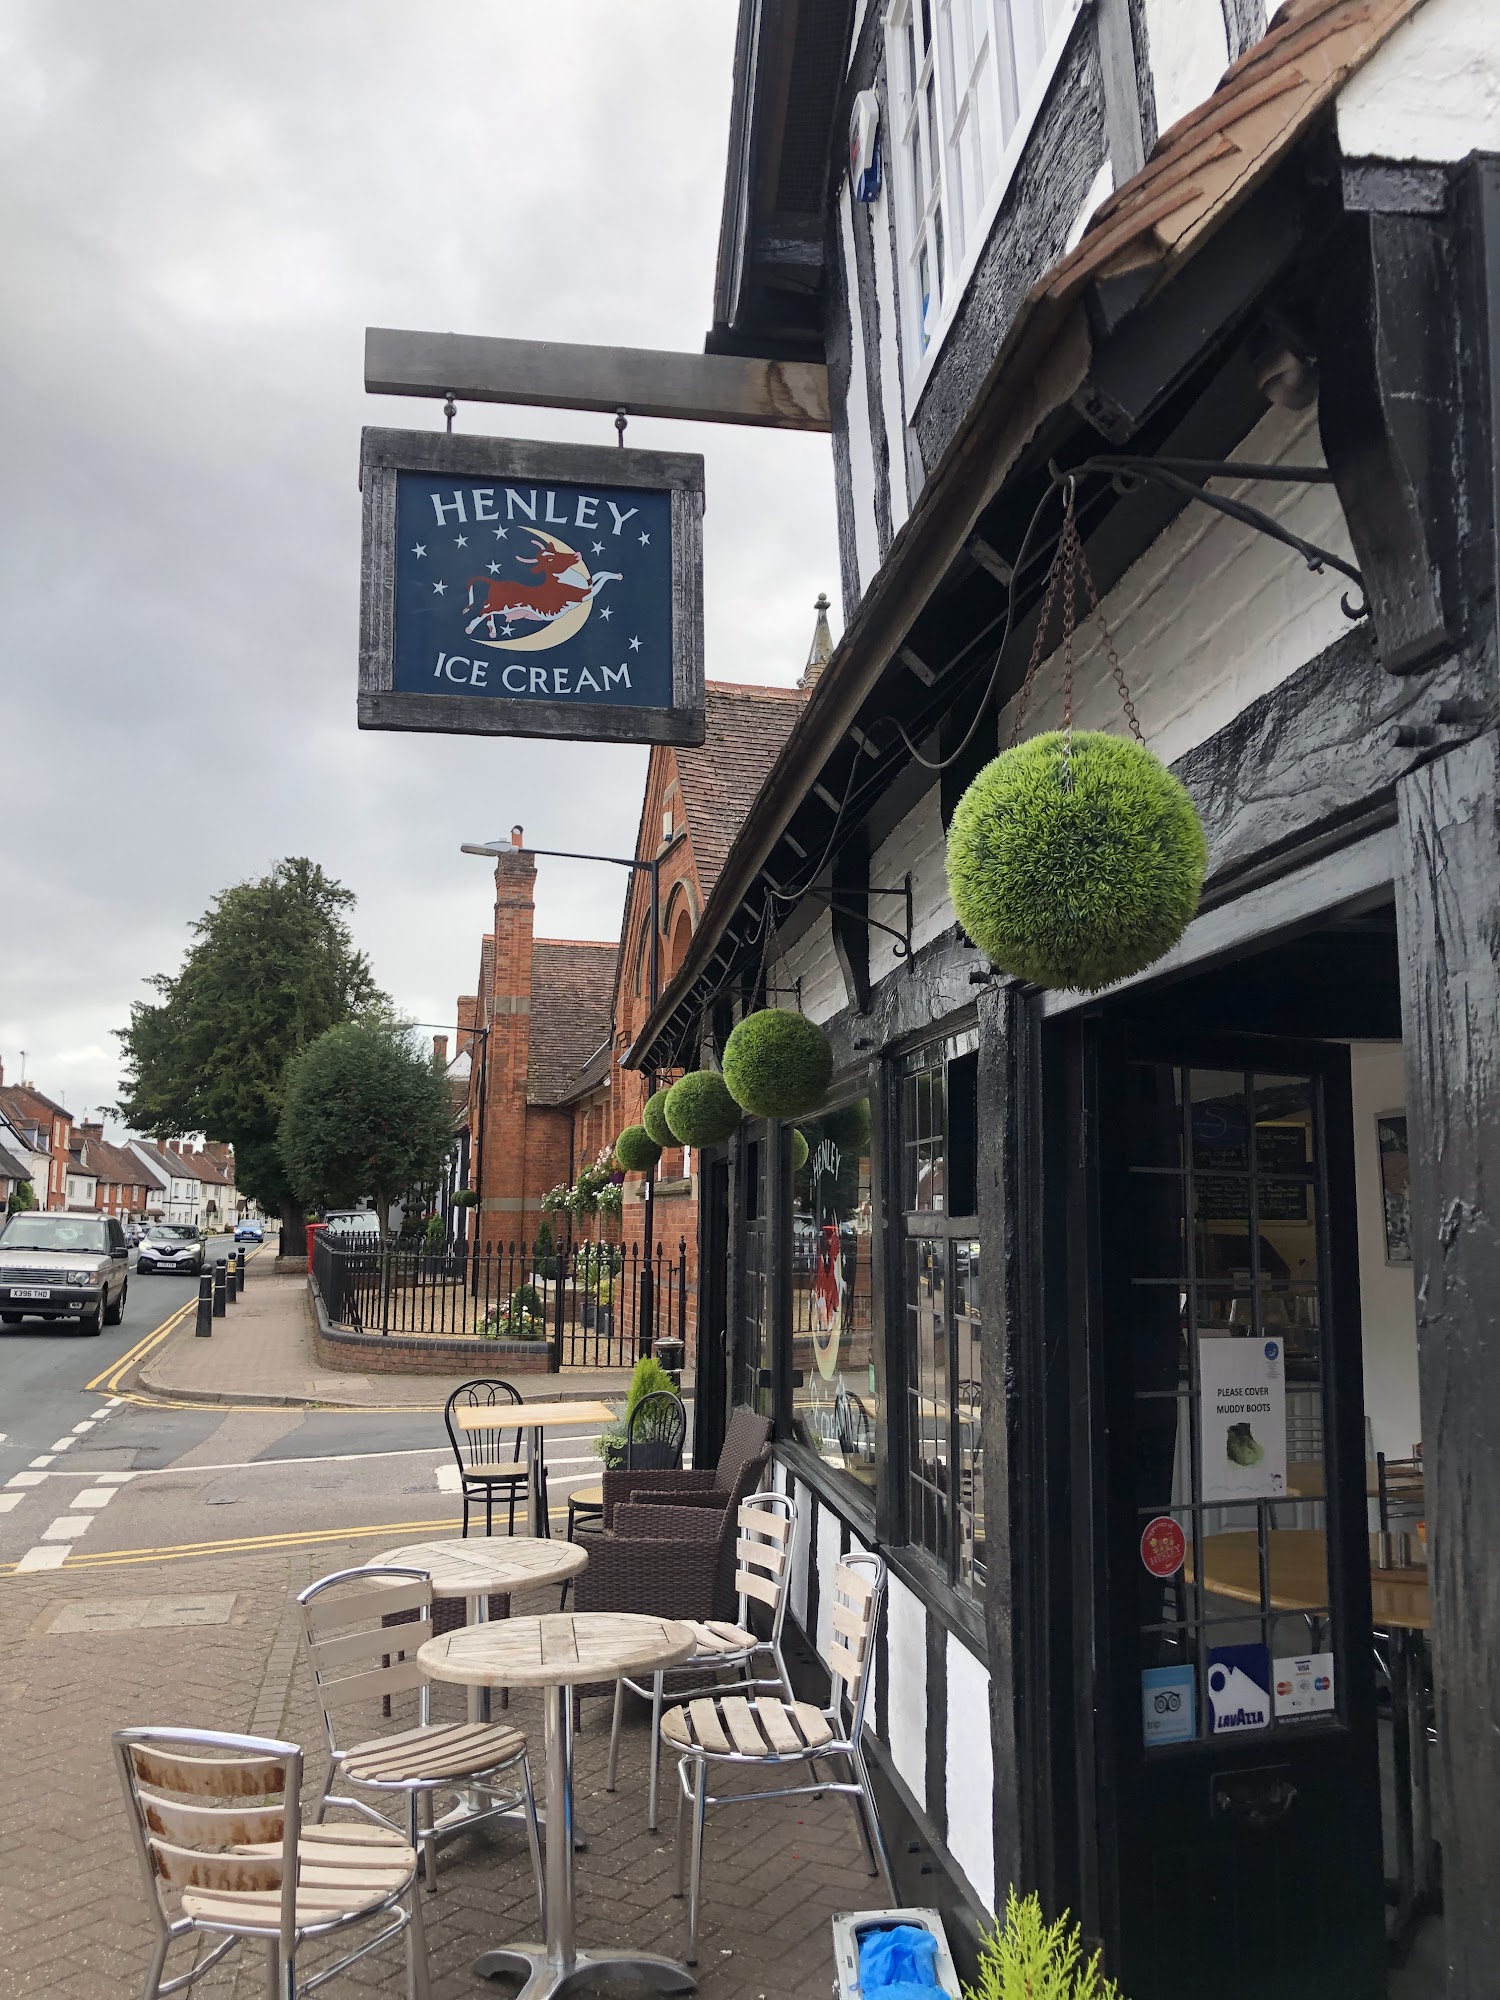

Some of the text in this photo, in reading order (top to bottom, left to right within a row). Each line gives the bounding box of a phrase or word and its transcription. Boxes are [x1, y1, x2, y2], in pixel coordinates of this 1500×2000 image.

[429, 487, 640, 536] HENLEY
[433, 652, 633, 695] ICE CREAM
[812, 1138, 842, 1187] HENLEY
[1217, 1387, 1270, 1397] PLEASE COVER
[1216, 1403, 1271, 1415] MUDDY BOOTS
[1297, 1664, 1310, 1672] VISA
[1217, 1708, 1265, 1729] LAVAZZA
